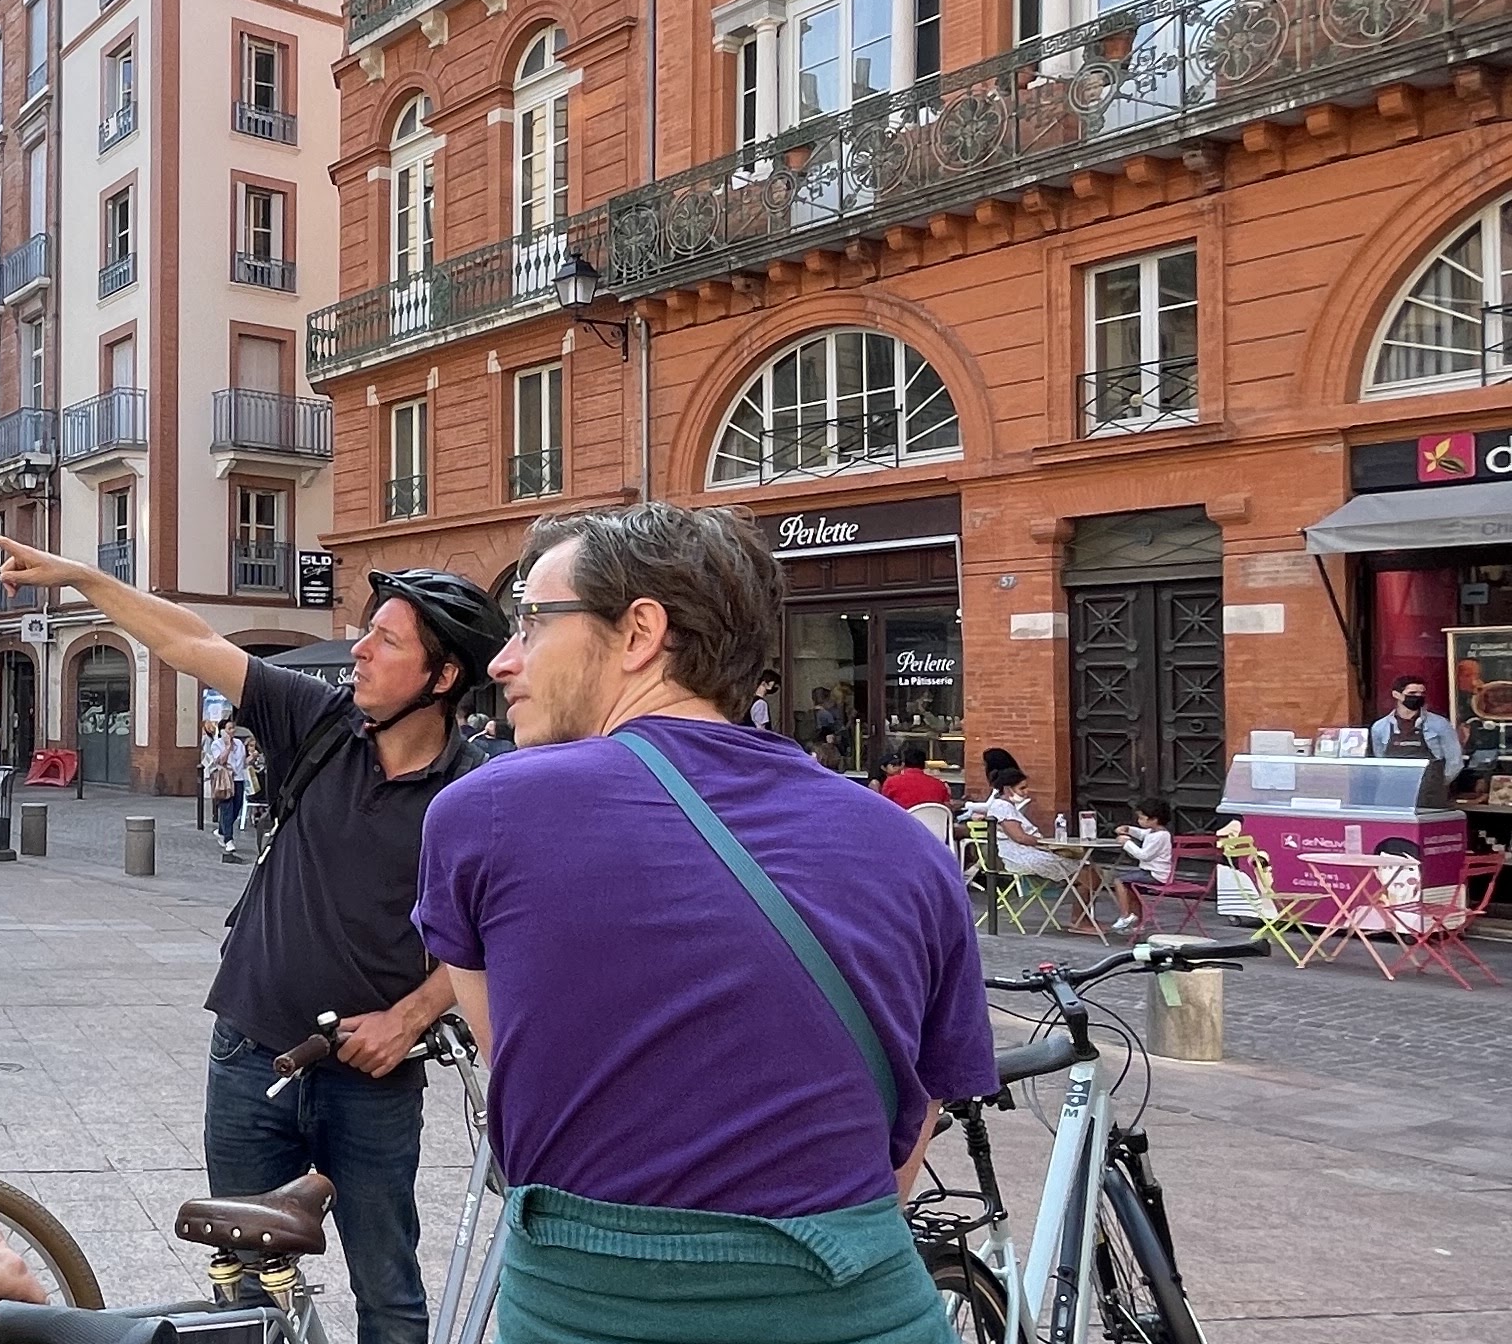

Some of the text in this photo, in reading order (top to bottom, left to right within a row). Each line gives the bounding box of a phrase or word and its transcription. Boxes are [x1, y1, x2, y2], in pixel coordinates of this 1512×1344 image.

[778, 514, 859, 548] Perlette
[301, 555, 332, 566] SLD
[1000, 576, 1015, 587] 57
[896, 650, 956, 673] Perlette
[898, 676, 910, 686] La
[1292, 877, 1351, 891] GOURNDS
